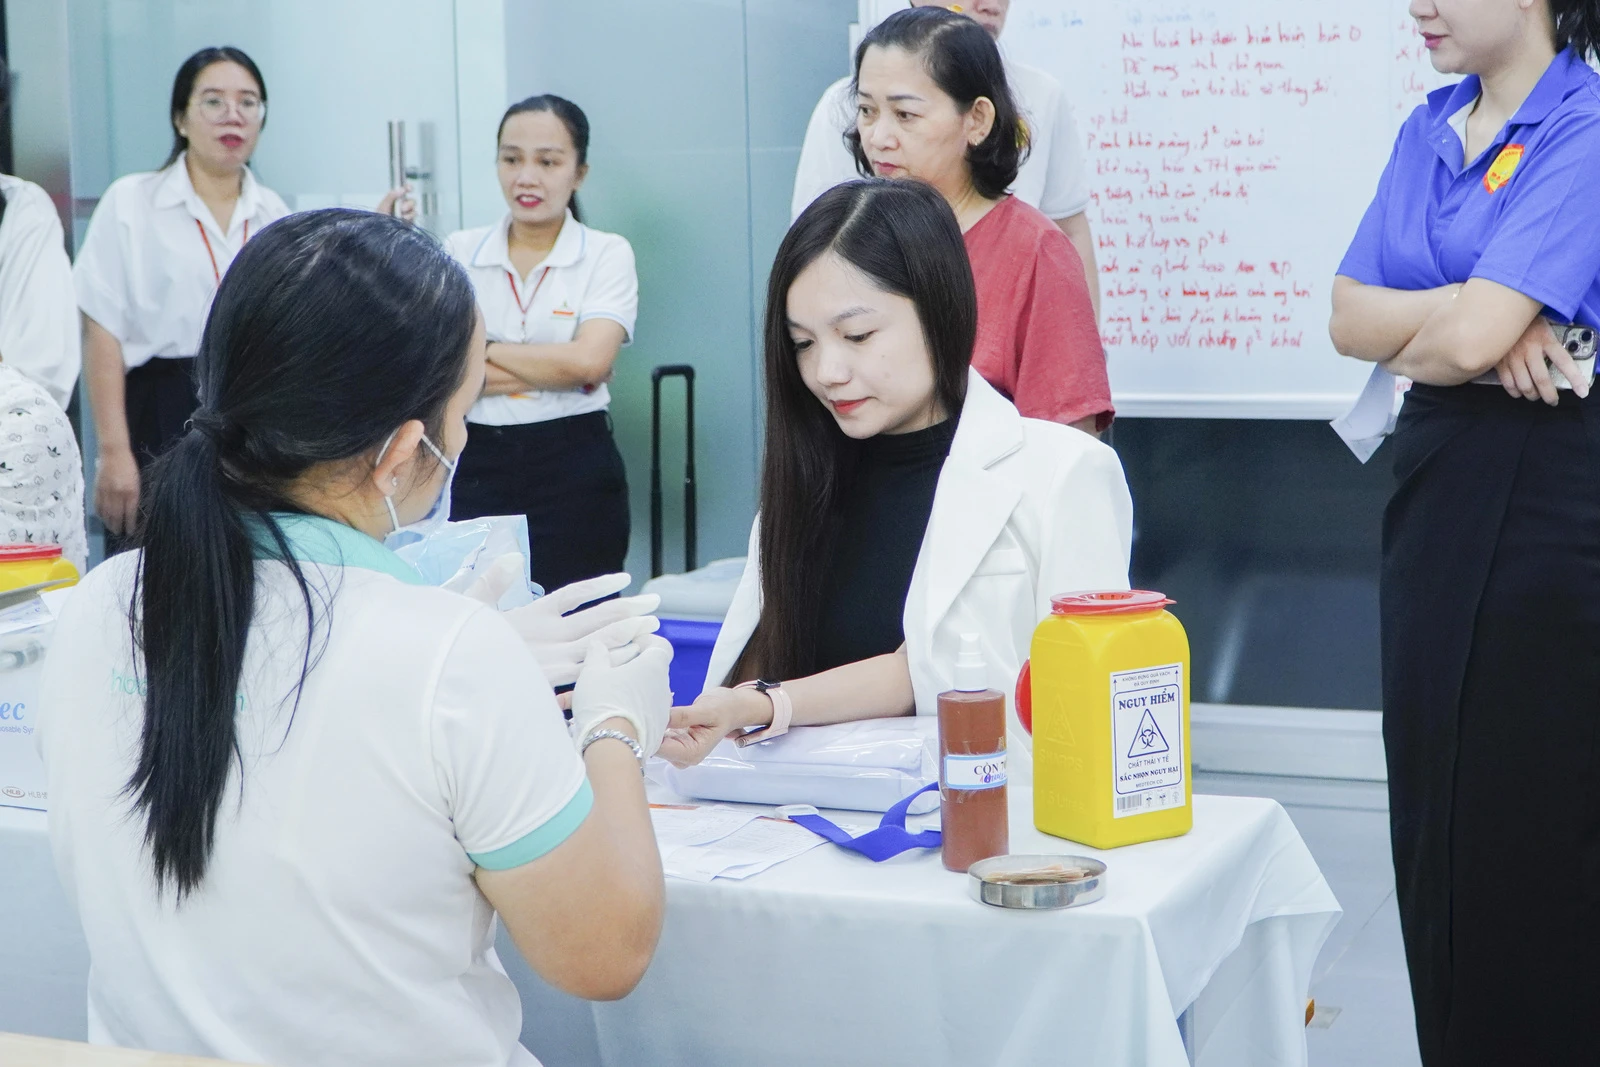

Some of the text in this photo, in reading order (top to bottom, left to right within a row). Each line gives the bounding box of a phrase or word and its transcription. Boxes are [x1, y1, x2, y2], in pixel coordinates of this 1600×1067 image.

[1118, 687, 1175, 711] NGUY HIỂM
[1150, 768, 1167, 776] NGUY
